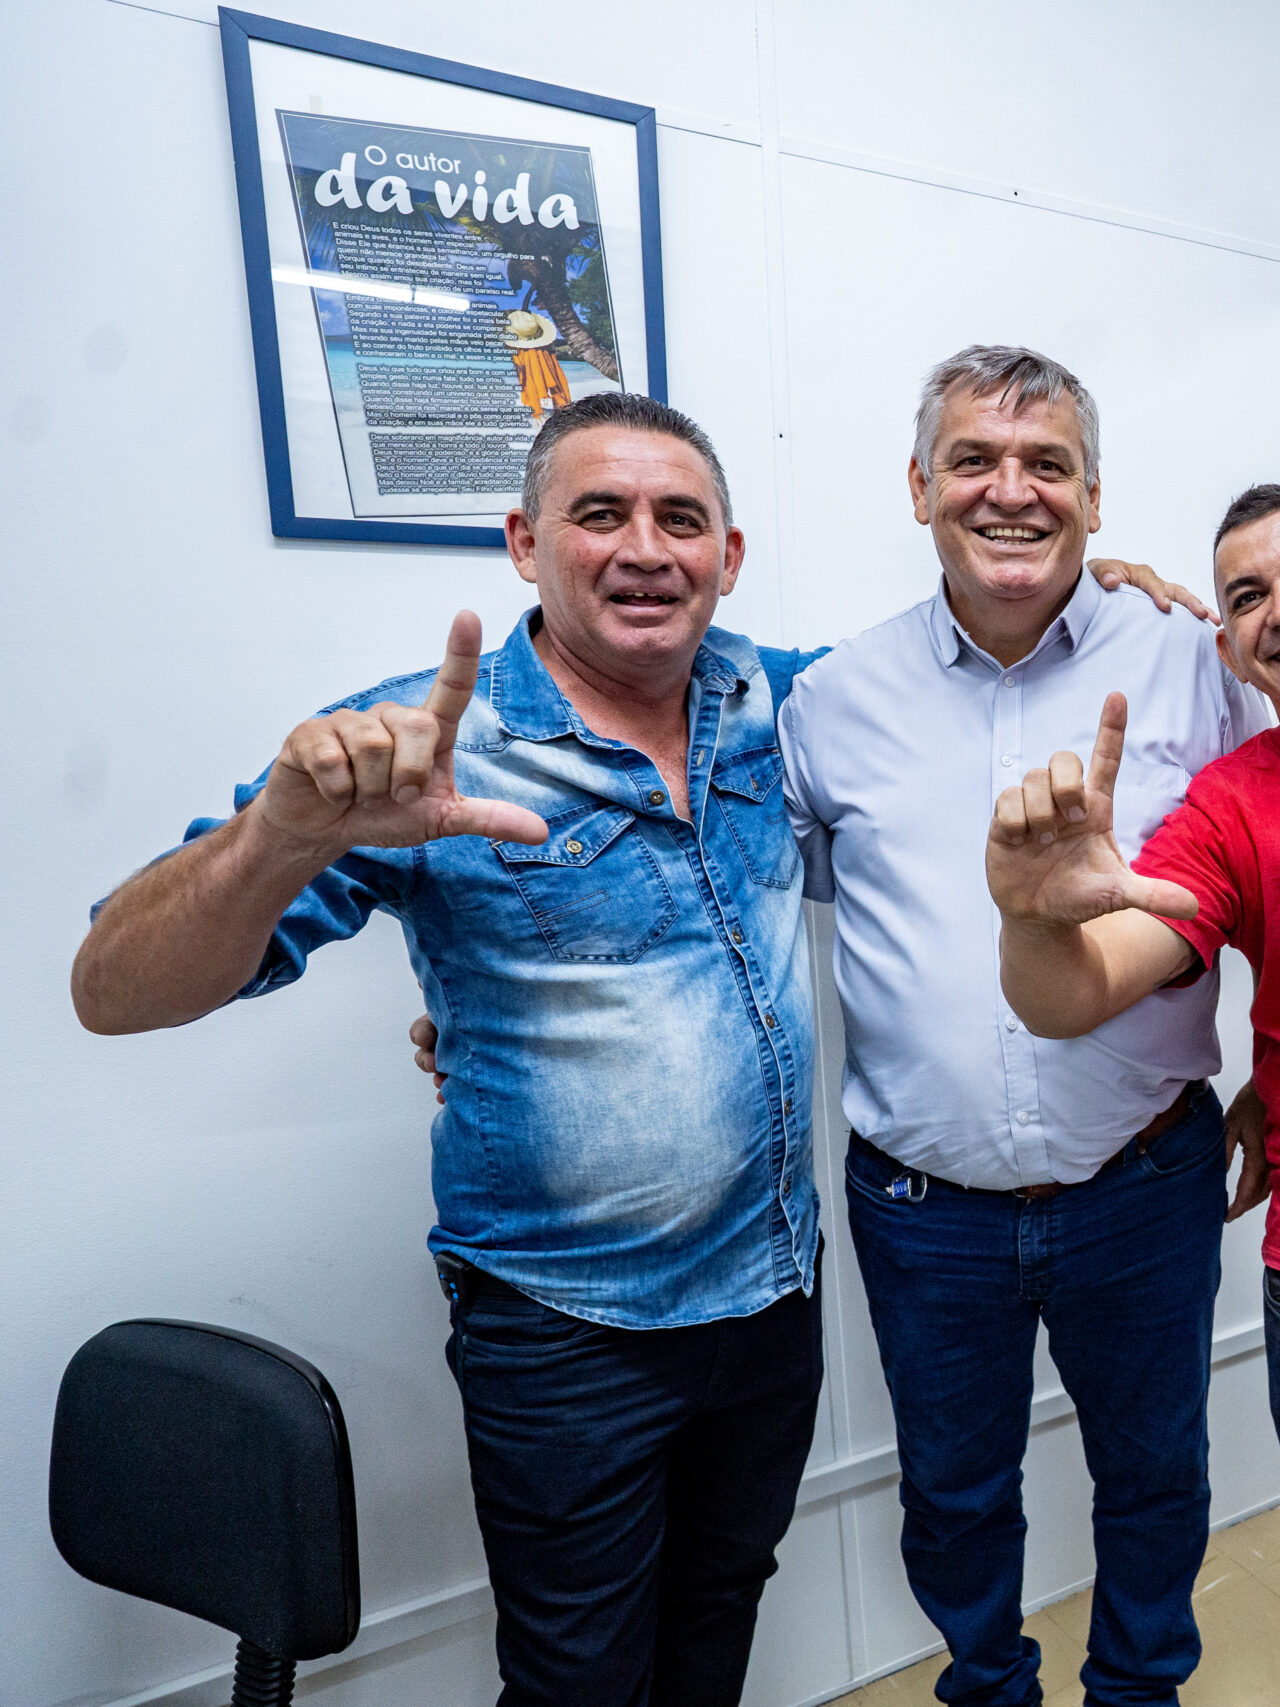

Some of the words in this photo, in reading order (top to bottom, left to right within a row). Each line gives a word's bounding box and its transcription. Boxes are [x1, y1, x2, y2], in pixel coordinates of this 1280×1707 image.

[364, 145, 387, 167] O
[396, 153, 461, 174] autor
[315, 152, 413, 215] da
[434, 170, 580, 230] vida
[360, 224, 380, 232] Deus
[381, 226, 402, 234] todos
[434, 231, 463, 239] viventes
[334, 230, 363, 238] animais
[405, 236, 432, 244] homem
[335, 238, 357, 246] Disse
[338, 254, 365, 264] Porque
[404, 252, 437, 260] grandeza
[390, 266, 429, 274] entristeceu
[346, 294, 375, 302] Embora
[348, 310, 382, 318] Segundo
[404, 313, 430, 321] palavra
[394, 328, 437, 336] ingenuidade
